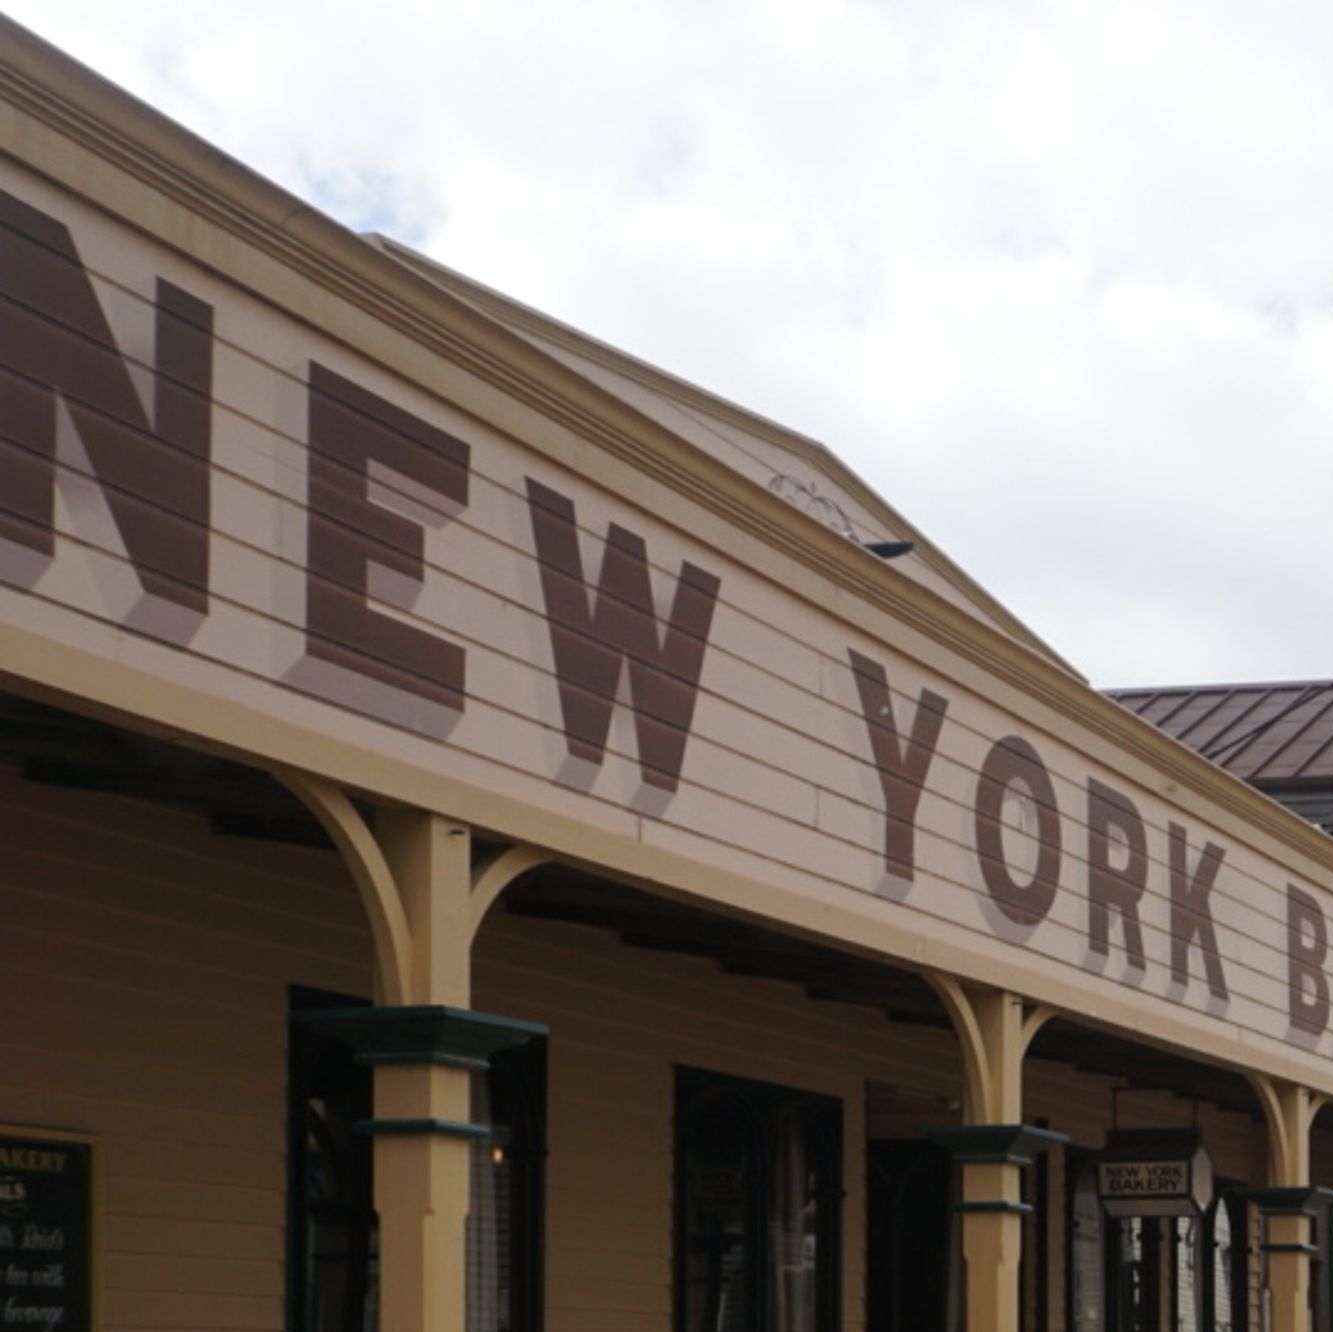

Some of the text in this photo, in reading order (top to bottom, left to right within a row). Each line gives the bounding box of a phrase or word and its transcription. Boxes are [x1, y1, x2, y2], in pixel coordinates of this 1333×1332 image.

[0, 188, 721, 795] NEW
[847, 647, 1229, 1001] YORK
[1106, 1165, 1182, 1179] NEW YORK
[1109, 1178, 1178, 1192] BAKERY
